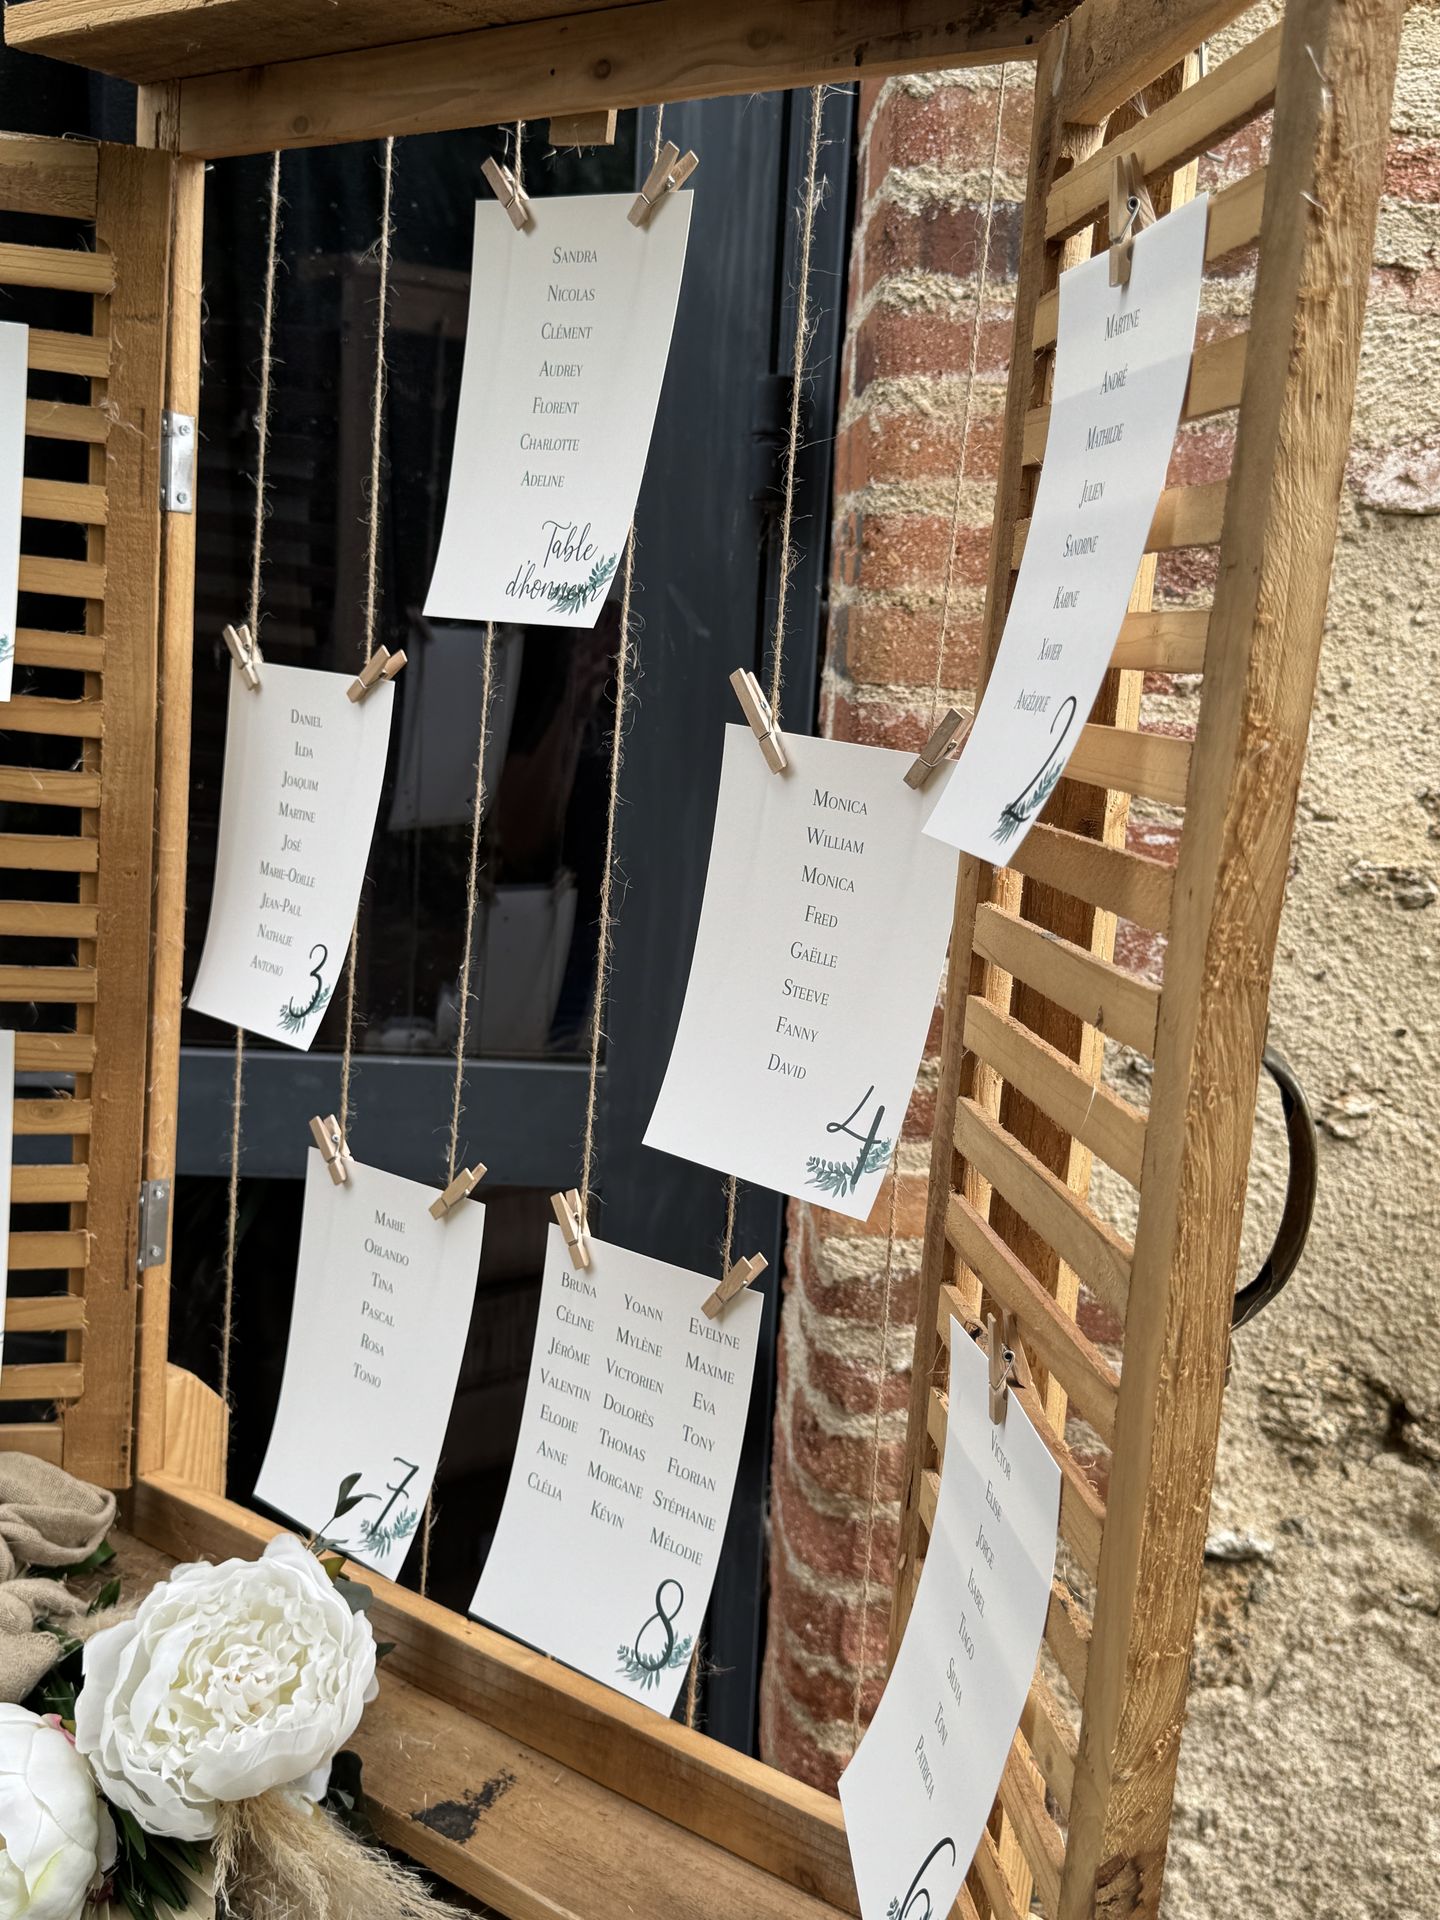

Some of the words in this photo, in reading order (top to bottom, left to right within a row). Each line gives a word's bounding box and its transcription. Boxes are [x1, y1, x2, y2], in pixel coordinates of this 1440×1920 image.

[552, 246, 598, 265] SANDRA
[547, 284, 596, 302] NICOLAS
[540, 321, 593, 340] CLÉMENT
[1104, 305, 1141, 342] MARTINE
[538, 359, 584, 377] AUDREY
[1099, 368, 1129, 396] ANDRÉ
[532, 396, 580, 415] FLORENT
[519, 432, 579, 452] CHARLOTTE
[1085, 422, 1125, 452] MATHILDE
[520, 469, 566, 488] ADELINE
[1078, 479, 1106, 510] JULIEN
[542, 519, 599, 567] Table
[1062, 533, 1099, 558] SANDRINE
[1036, 637, 1063, 661] XAVIER
[290, 708, 323, 729] DANIEL
[294, 740, 314, 759] ILDA
[1004, 695, 1077, 822] 2
[280, 770, 319, 792] JOAQUIM
[277, 801, 316, 824] MARTINE
[812, 788, 868, 816] MONICA
[280, 833, 303, 853] JOSÉ
[807, 826, 865, 855] WILLIAM
[801, 864, 855, 893] MONICA
[258, 891, 302, 917] JEAN-PAUL
[804, 904, 838, 928] FRED
[256, 922, 293, 947] NATHALIE
[249, 954, 284, 977] ANTONIO
[790, 941, 838, 969] GAËLLE
[289, 943, 328, 1018] 3
[781, 978, 830, 1007] STEEVE
[775, 1015, 819, 1043] FANNY
[767, 1053, 807, 1080] DAVID
[826, 1085, 887, 1185] 4
[374, 1209, 405, 1233] MARIE
[363, 1237, 410, 1267] ORLANDO
[371, 1271, 394, 1294] TINA
[561, 1269, 597, 1299] BRUNA
[360, 1300, 395, 1328] PASCAL
[555, 1304, 595, 1333] CÉLINE
[624, 1293, 664, 1322] YOANN
[360, 1332, 385, 1357] ROSA
[615, 1326, 663, 1358] MYLÈNE
[688, 1315, 741, 1351] EVELYNE
[547, 1336, 591, 1366] JÉRÔME
[605, 1357, 664, 1396] VICTORIEN
[685, 1351, 735, 1384] MAXIME
[540, 1367, 592, 1402] VALENTIN
[602, 1392, 655, 1428] DOLORÈS
[692, 1391, 716, 1416] EVA
[539, 1403, 579, 1434] ELODIE
[536, 1439, 569, 1466] ANNE
[599, 1427, 646, 1462] THOMAS
[682, 1423, 716, 1453] TONY
[991, 1427, 1012, 1481] VICTOR
[527, 1471, 562, 1502] CLÉLIA
[587, 1458, 645, 1500] MORGANE
[667, 1456, 716, 1492] FLORIAN
[370, 1457, 419, 1535] 7
[652, 1487, 717, 1533] STÉPHANIE
[590, 1499, 625, 1529] KÉVIN
[649, 1526, 703, 1566] MÉLODIE
[635, 1578, 684, 1671] 8
[914, 1733, 935, 1801] PATRICIA
